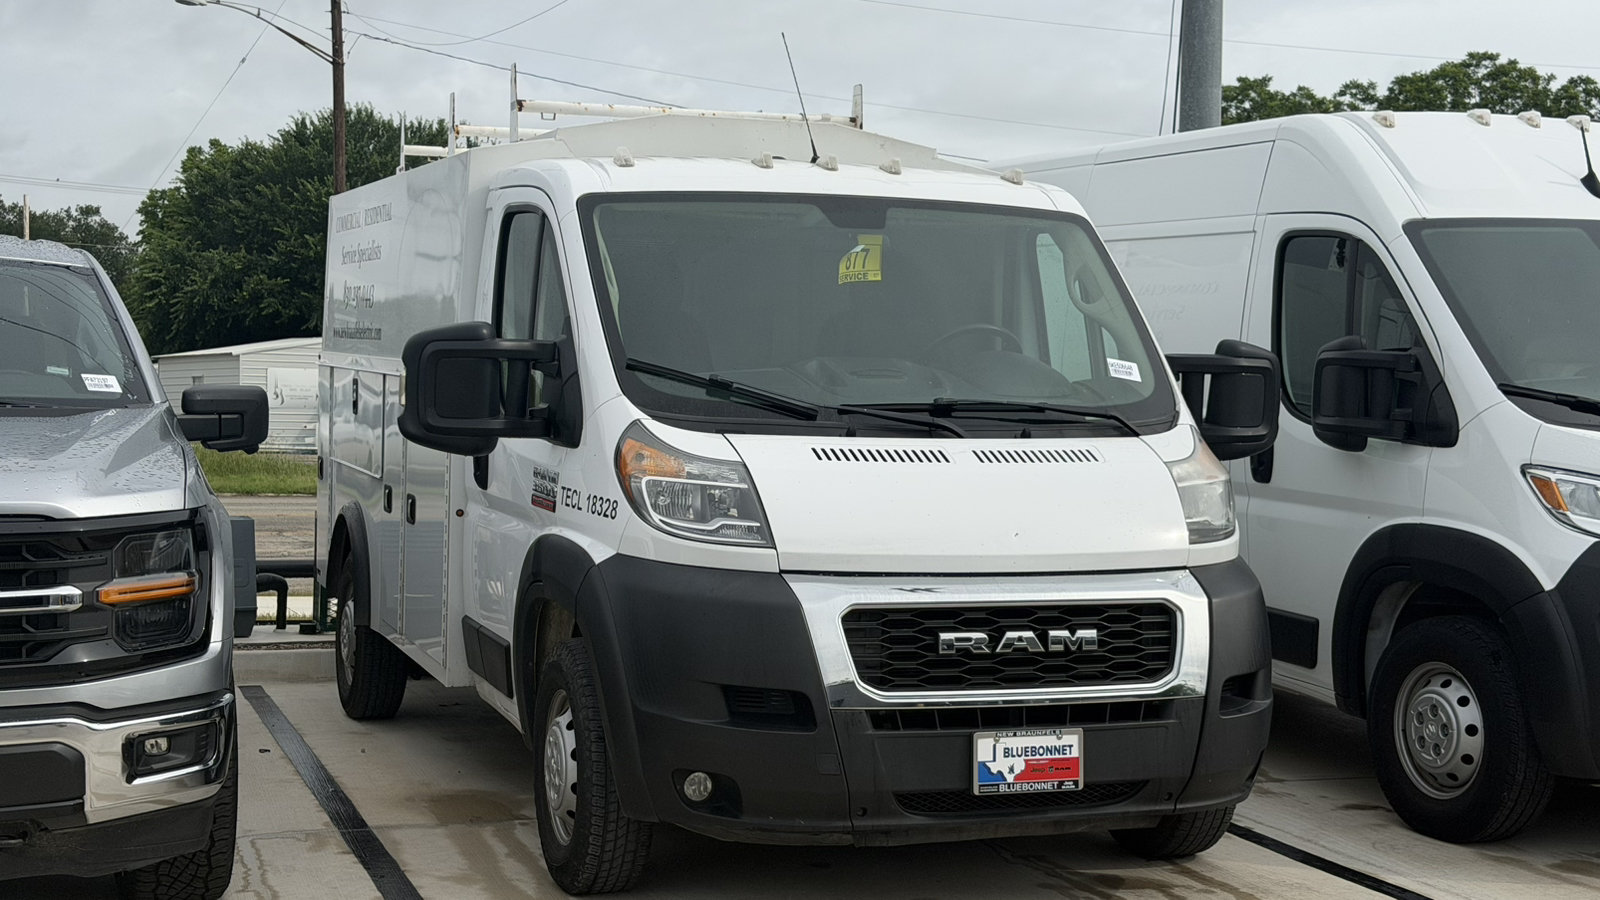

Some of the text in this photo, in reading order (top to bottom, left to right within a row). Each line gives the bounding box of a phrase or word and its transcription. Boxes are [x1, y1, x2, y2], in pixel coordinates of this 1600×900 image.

[341, 239, 382, 269] Service Specialists
[560, 486, 582, 511] TECL
[586, 493, 619, 520] 18328
[938, 629, 1098, 654] RAM
[1016, 729, 1061, 737] BRAUNFELS
[1003, 744, 1074, 758] BLUEBONNET
[999, 781, 1058, 792] BLUEBONNET
